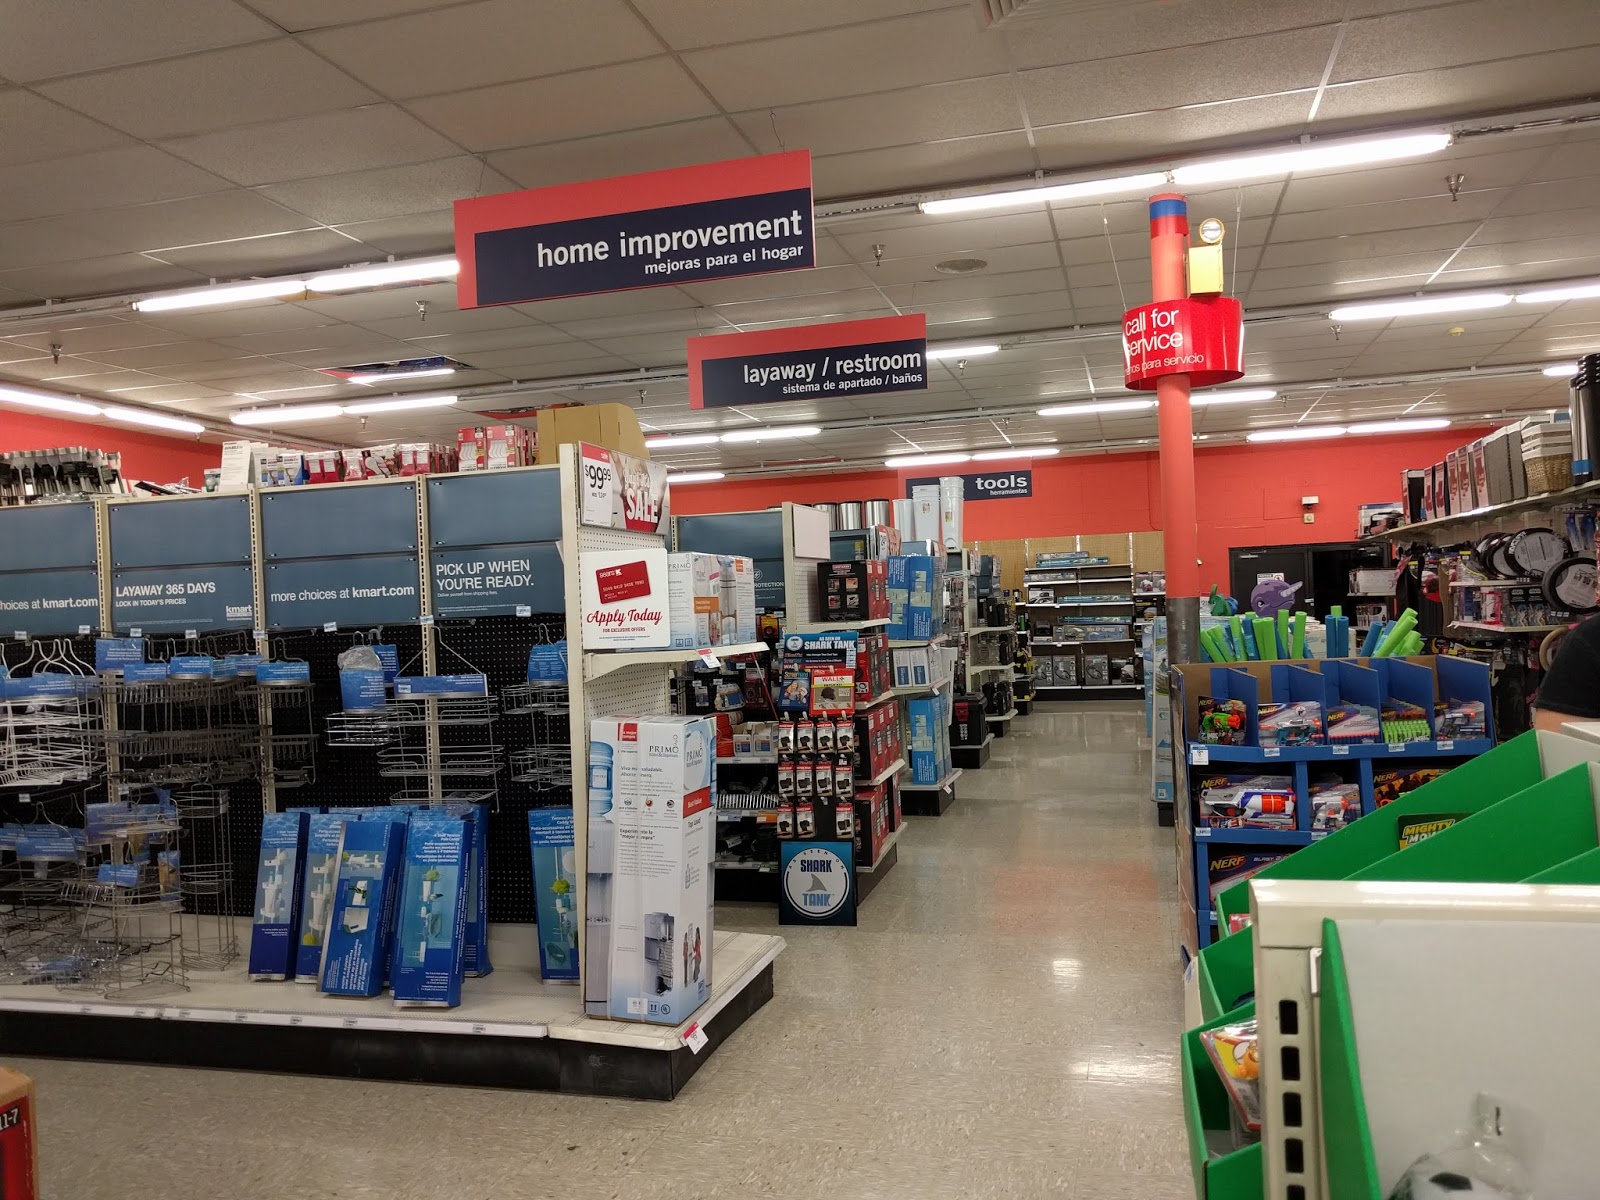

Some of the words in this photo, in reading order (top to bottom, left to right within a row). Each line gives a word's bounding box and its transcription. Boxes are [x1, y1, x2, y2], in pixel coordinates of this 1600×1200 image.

[537, 242, 609, 268] home
[620, 210, 802, 259] improvement
[645, 258, 701, 274] mejoras
[706, 254, 738, 269] para
[743, 249, 756, 262] el
[762, 246, 803, 260] hogar
[1125, 311, 1146, 336] call
[1151, 309, 1179, 328] for
[744, 363, 816, 386] layaway
[822, 357, 829, 376] /
[836, 353, 921, 375] restroom
[1142, 359, 1161, 372] para
[1164, 353, 1204, 366] servicio
[783, 382, 820, 394] sistema
[824, 380, 836, 390] de
[839, 376, 882, 390] apartado
[885, 375, 889, 385] /
[893, 373, 922, 384] baños
[976, 475, 1028, 489] tools
[626, 488, 658, 523] SALE
[436, 563, 464, 576] PICK
[467, 561, 485, 574] UP
[488, 559, 530, 573] WHEN
[116, 584, 164, 598] LAYAWAY
[166, 583, 185, 595] 365
[187, 582, 216, 594] DAYS
[437, 577, 482, 591] YOU'RE
[486, 575, 534, 589] READY.
[271, 591, 297, 602] more
[299, 588, 337, 601] choices
[340, 588, 350, 599] at
[352, 586, 415, 599] kmart.com
[31, 599, 41, 609] at
[42, 598, 98, 609] kmart.com
[116, 600, 131, 608] LOCK
[140, 599, 164, 607] TODAY'S
[226, 605, 253, 613] kmart
[587, 609, 627, 627] Apply
[628, 608, 663, 626] Today
[804, 641, 832, 649] SHARK
[834, 640, 855, 649] TANK
[1328, 711, 1347, 721] NERF
[649, 745, 679, 753] PRIMO
[1201, 777, 1229, 789] NERF
[1374, 772, 1398, 783] NERF
[1405, 821, 1452, 835] MIGHTY
[801, 860, 832, 872] SHARK
[1210, 856, 1246, 871] NERF
[803, 893, 832, 906] TANK
